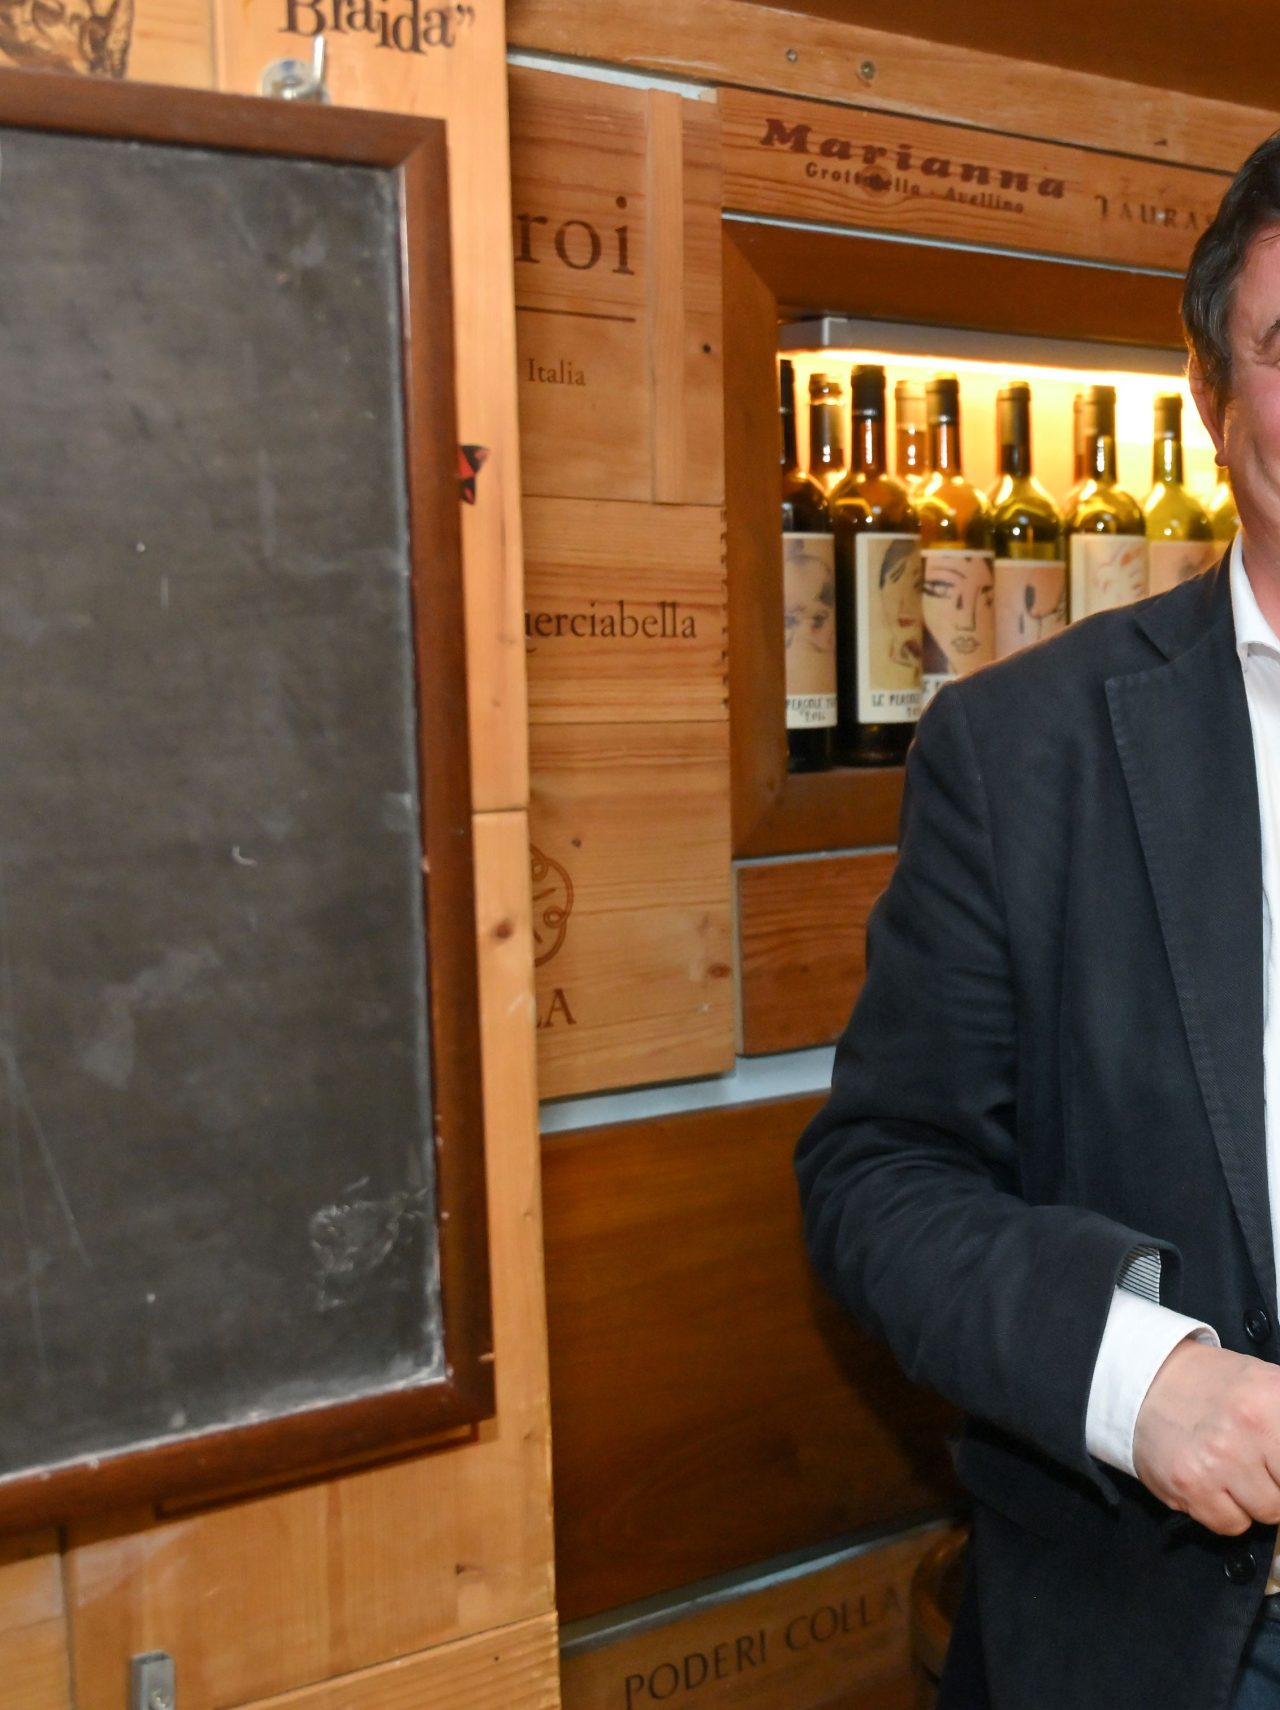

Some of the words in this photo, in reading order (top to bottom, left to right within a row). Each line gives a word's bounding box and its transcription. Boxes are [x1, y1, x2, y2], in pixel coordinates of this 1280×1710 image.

[760, 118, 1066, 200] Marianna
[945, 187, 1024, 214] Avellino
[527, 357, 587, 387] Italia
[624, 1630, 767, 1710] PODERI
[785, 1585, 900, 1651] COLLA
